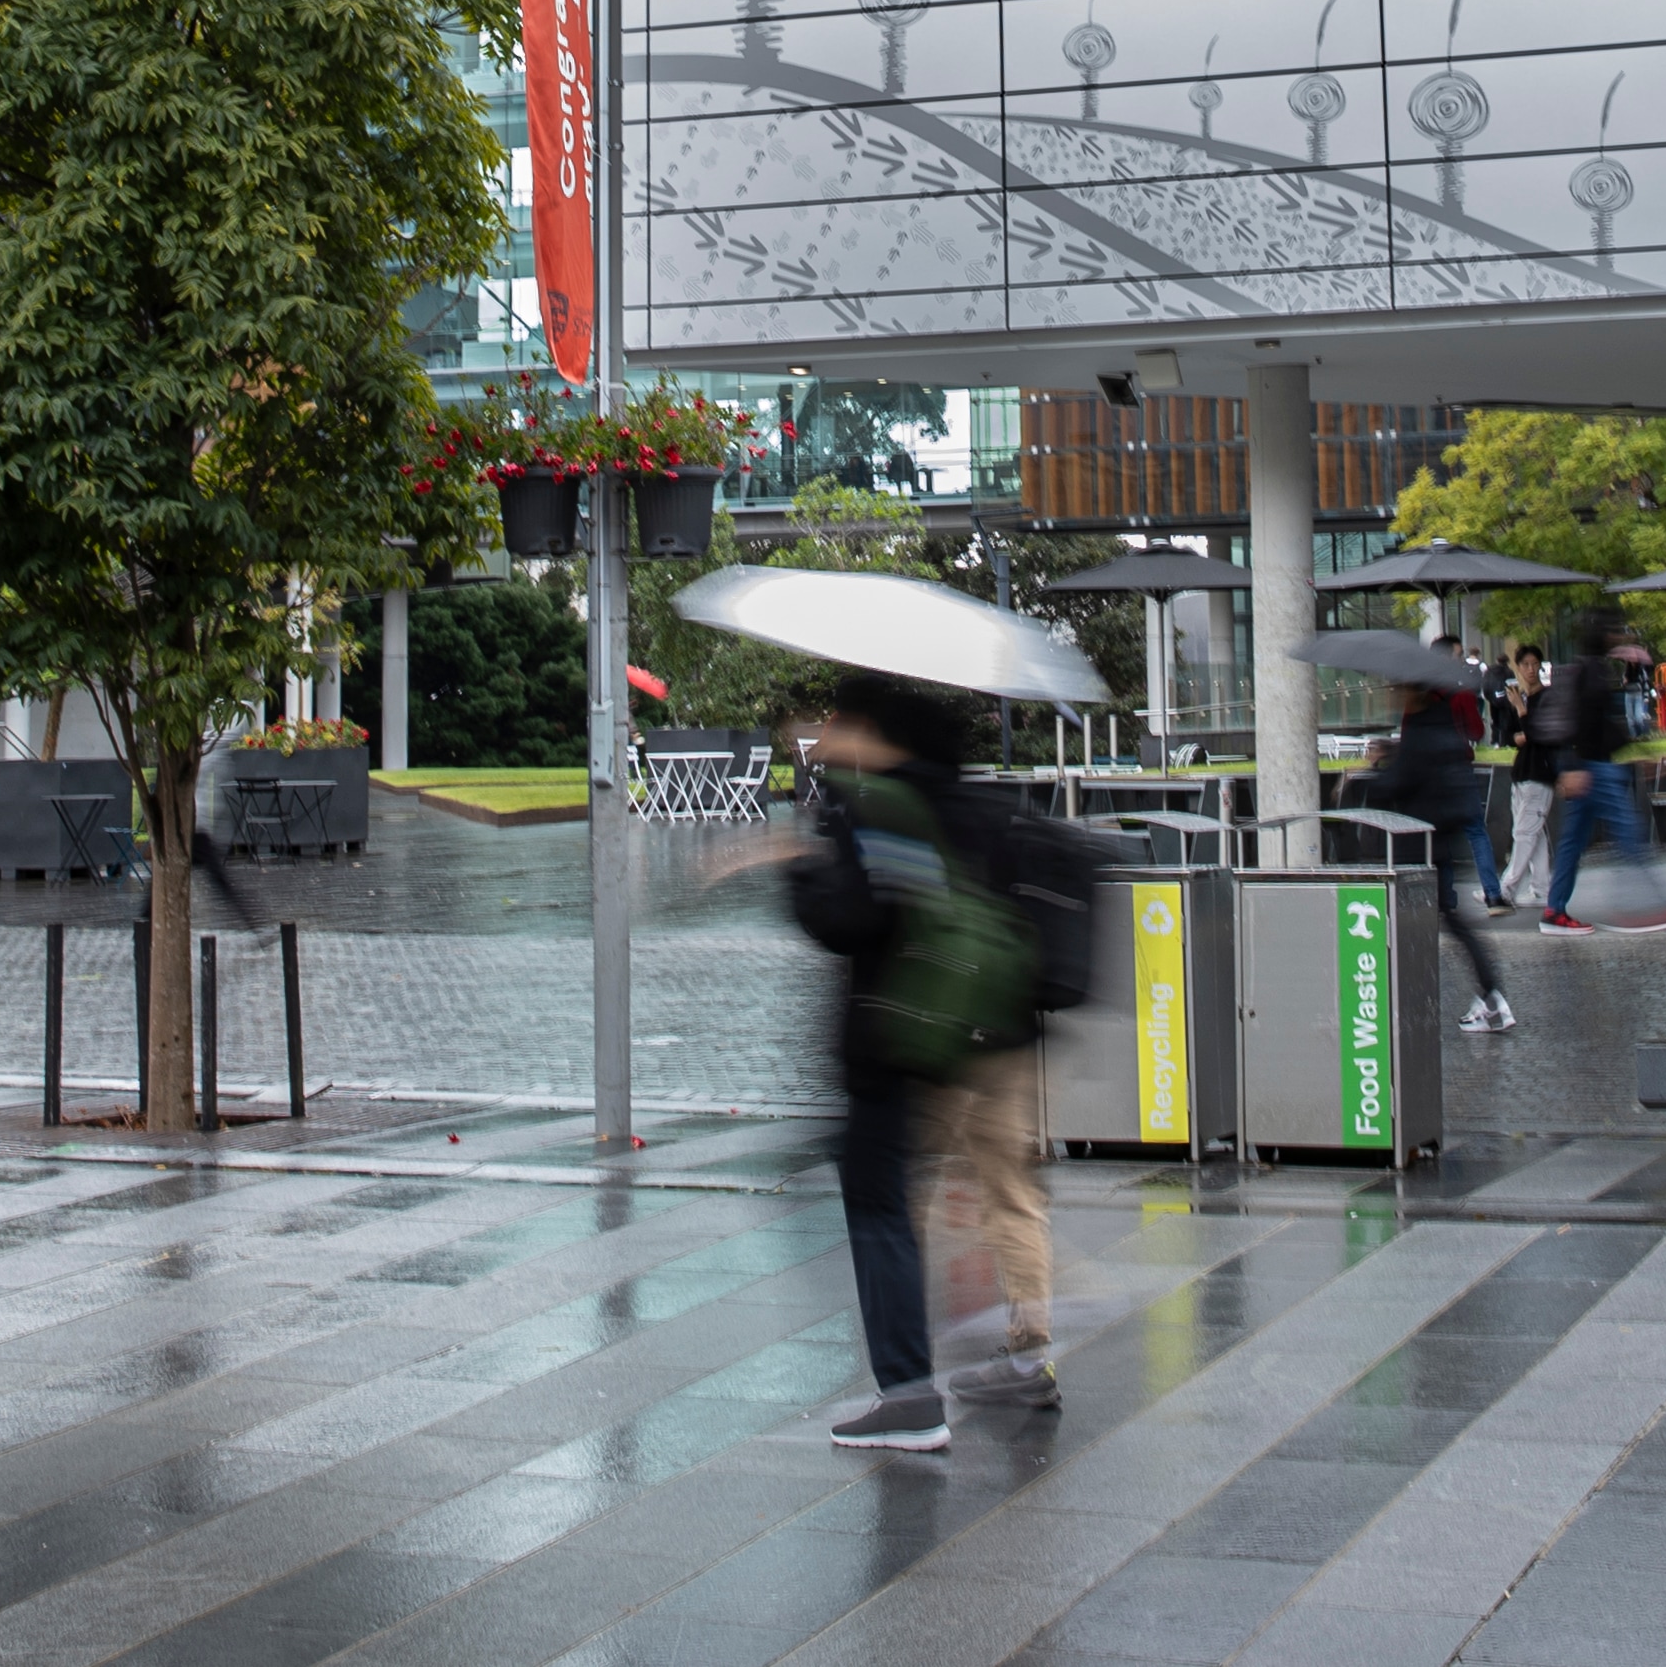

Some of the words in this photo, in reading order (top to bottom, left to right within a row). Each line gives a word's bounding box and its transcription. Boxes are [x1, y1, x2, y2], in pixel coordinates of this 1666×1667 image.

[1352, 952, 1379, 1050] Waste
[1150, 982, 1177, 1130] Recycling
[1354, 1057, 1381, 1136] Food
